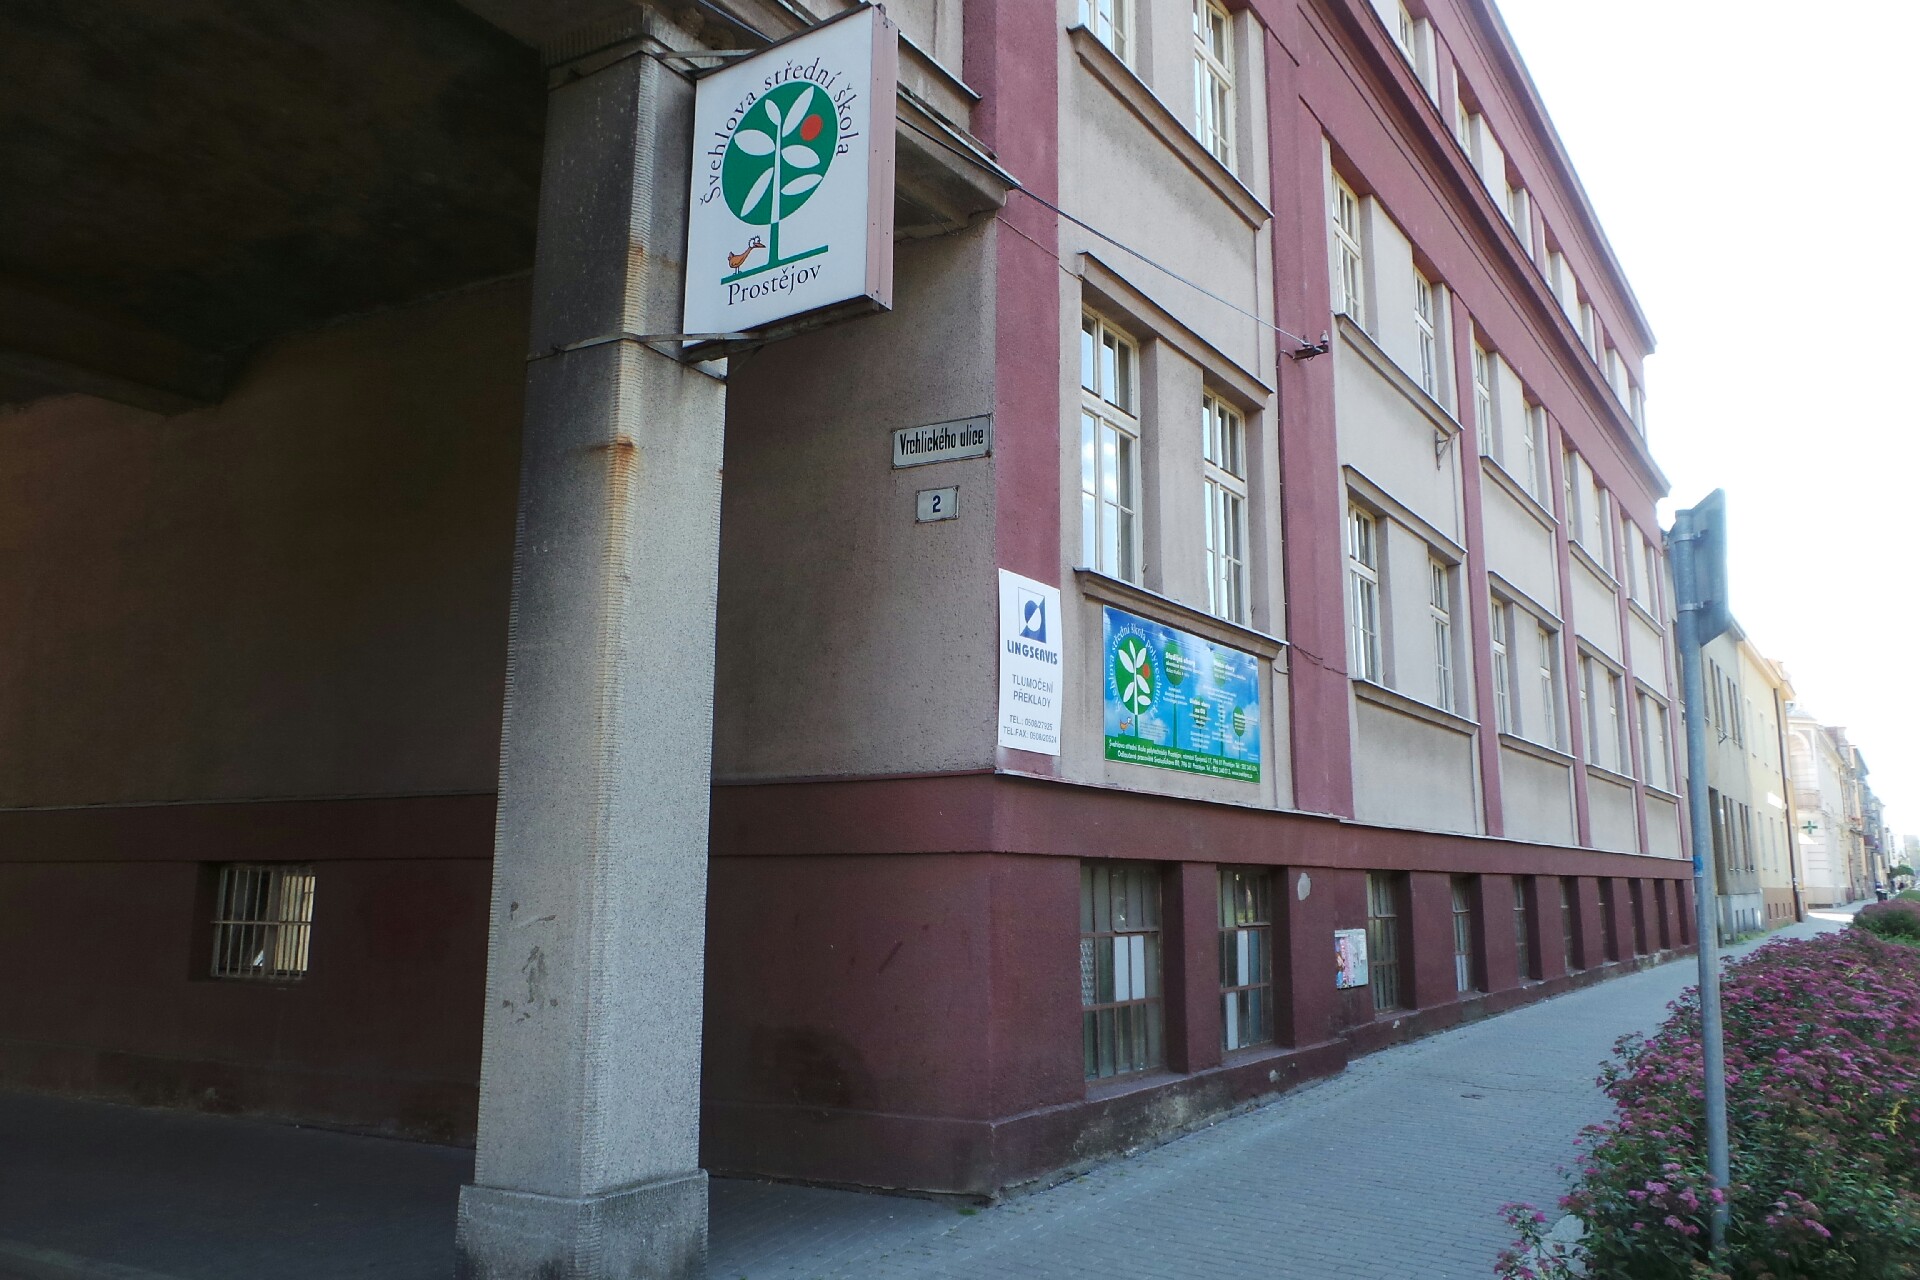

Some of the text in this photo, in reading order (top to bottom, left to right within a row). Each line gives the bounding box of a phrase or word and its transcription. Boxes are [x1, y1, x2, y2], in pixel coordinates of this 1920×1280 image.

[700, 57, 860, 205] Švehlova střední škola
[727, 264, 822, 306] Prostějov
[900, 424, 984, 455] Vrchlického ulice
[932, 494, 941, 513] 2
[1007, 639, 1058, 665] LINGSERVIS
[1012, 673, 1054, 694] TLUMOČENÍ
[1013, 688, 1052, 708] PŘEKLADY
